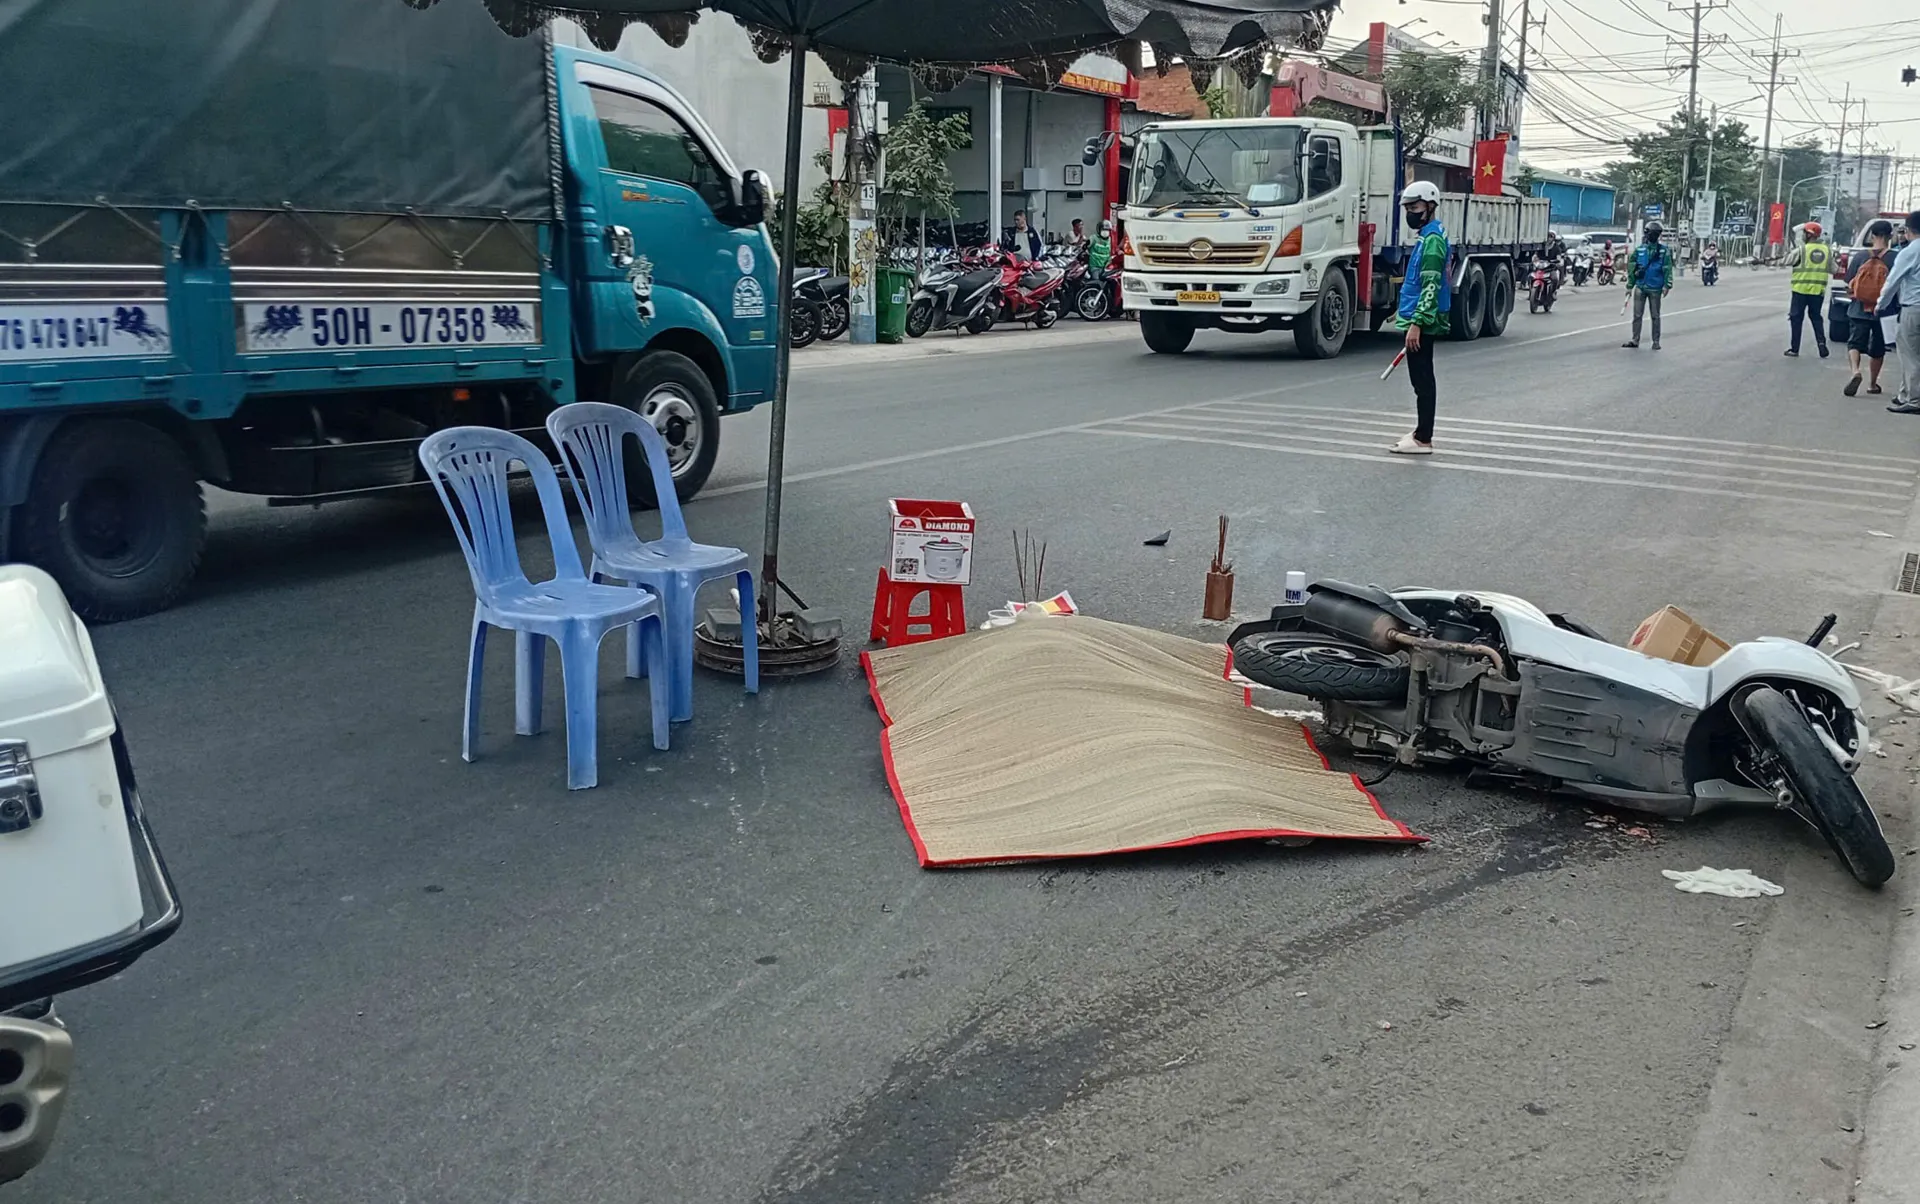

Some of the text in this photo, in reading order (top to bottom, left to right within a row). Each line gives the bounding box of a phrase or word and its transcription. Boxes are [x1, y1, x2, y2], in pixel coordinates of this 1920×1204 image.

[862, 185, 875, 199] 13
[311, 306, 372, 346] 50H
[399, 306, 487, 344] 07358
[924, 521, 971, 532] DIAMOND
